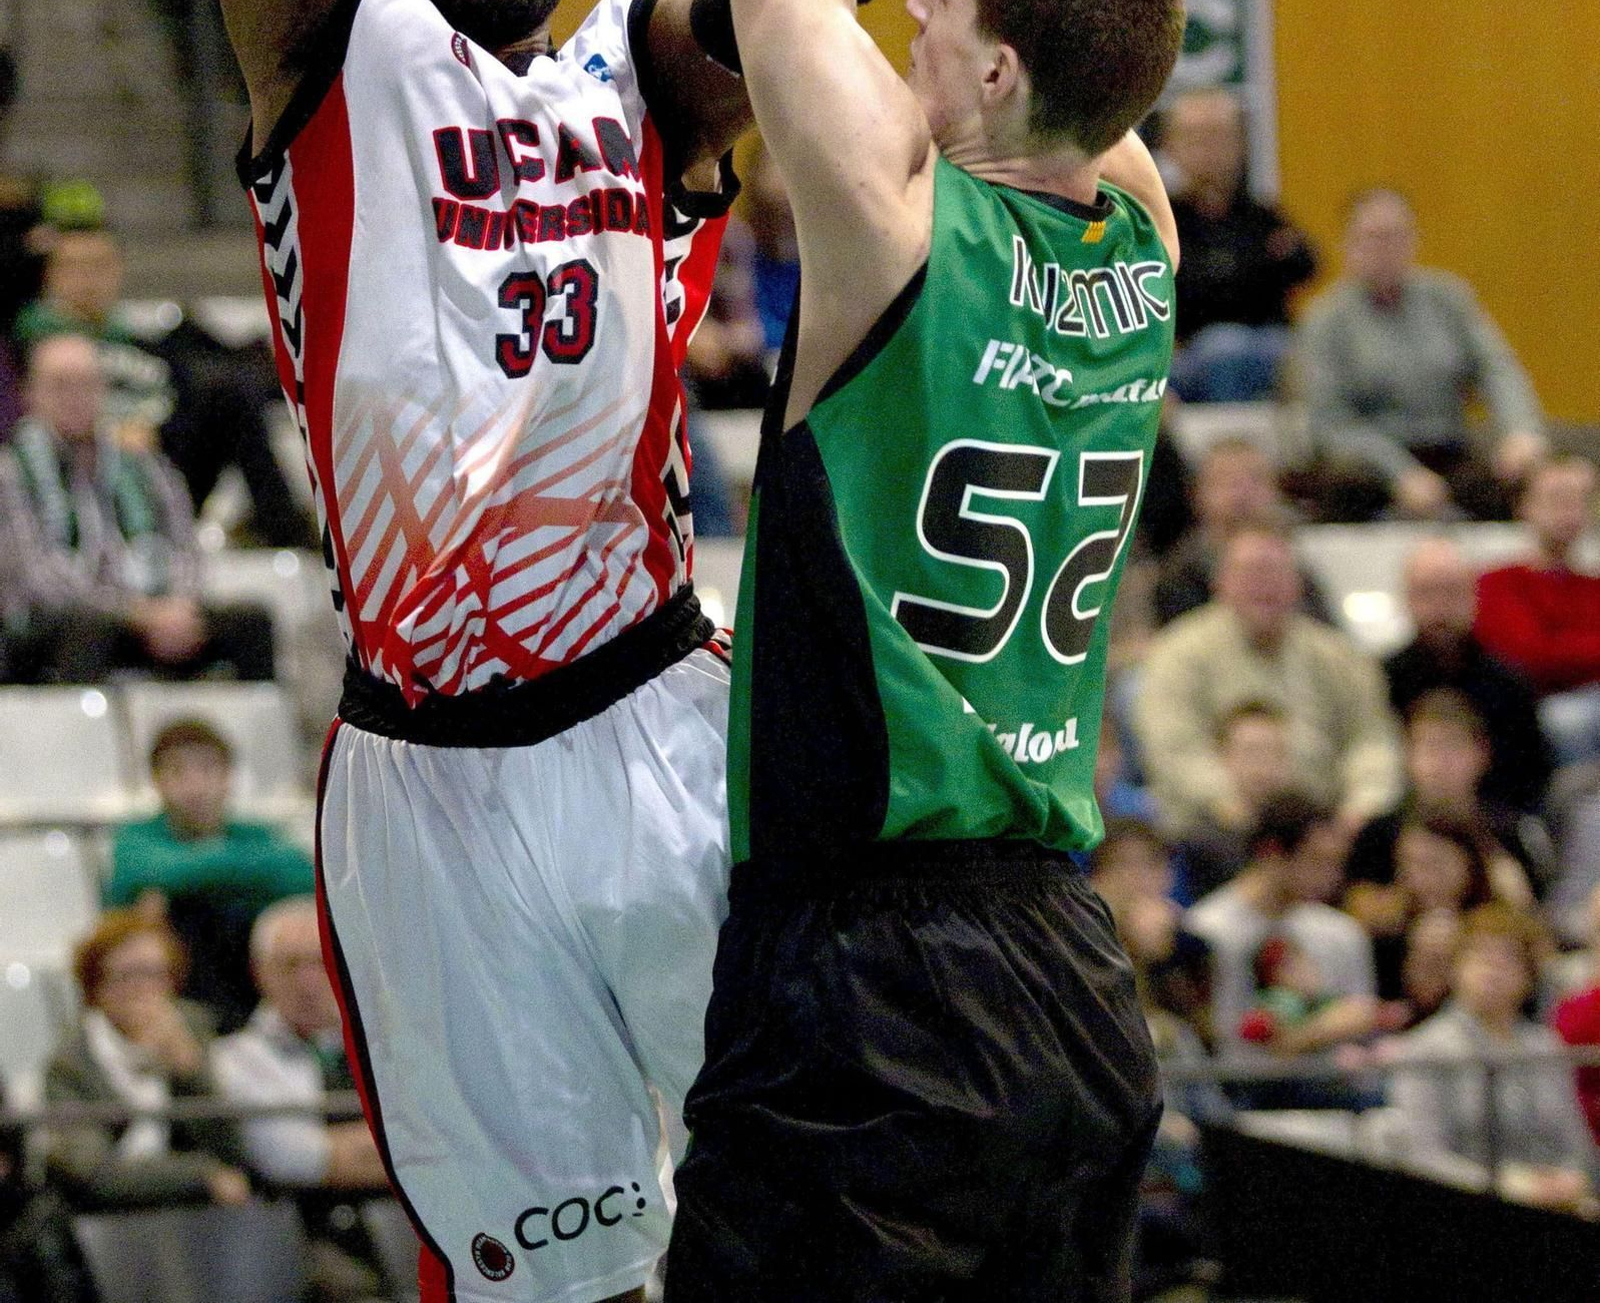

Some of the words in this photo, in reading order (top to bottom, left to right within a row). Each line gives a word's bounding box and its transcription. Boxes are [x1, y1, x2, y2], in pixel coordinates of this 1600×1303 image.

[432, 188, 650, 250] UNIVERSIDA
[496, 259, 599, 379] 33
[891, 438, 1144, 664] 52
[513, 1181, 647, 1251] COC
